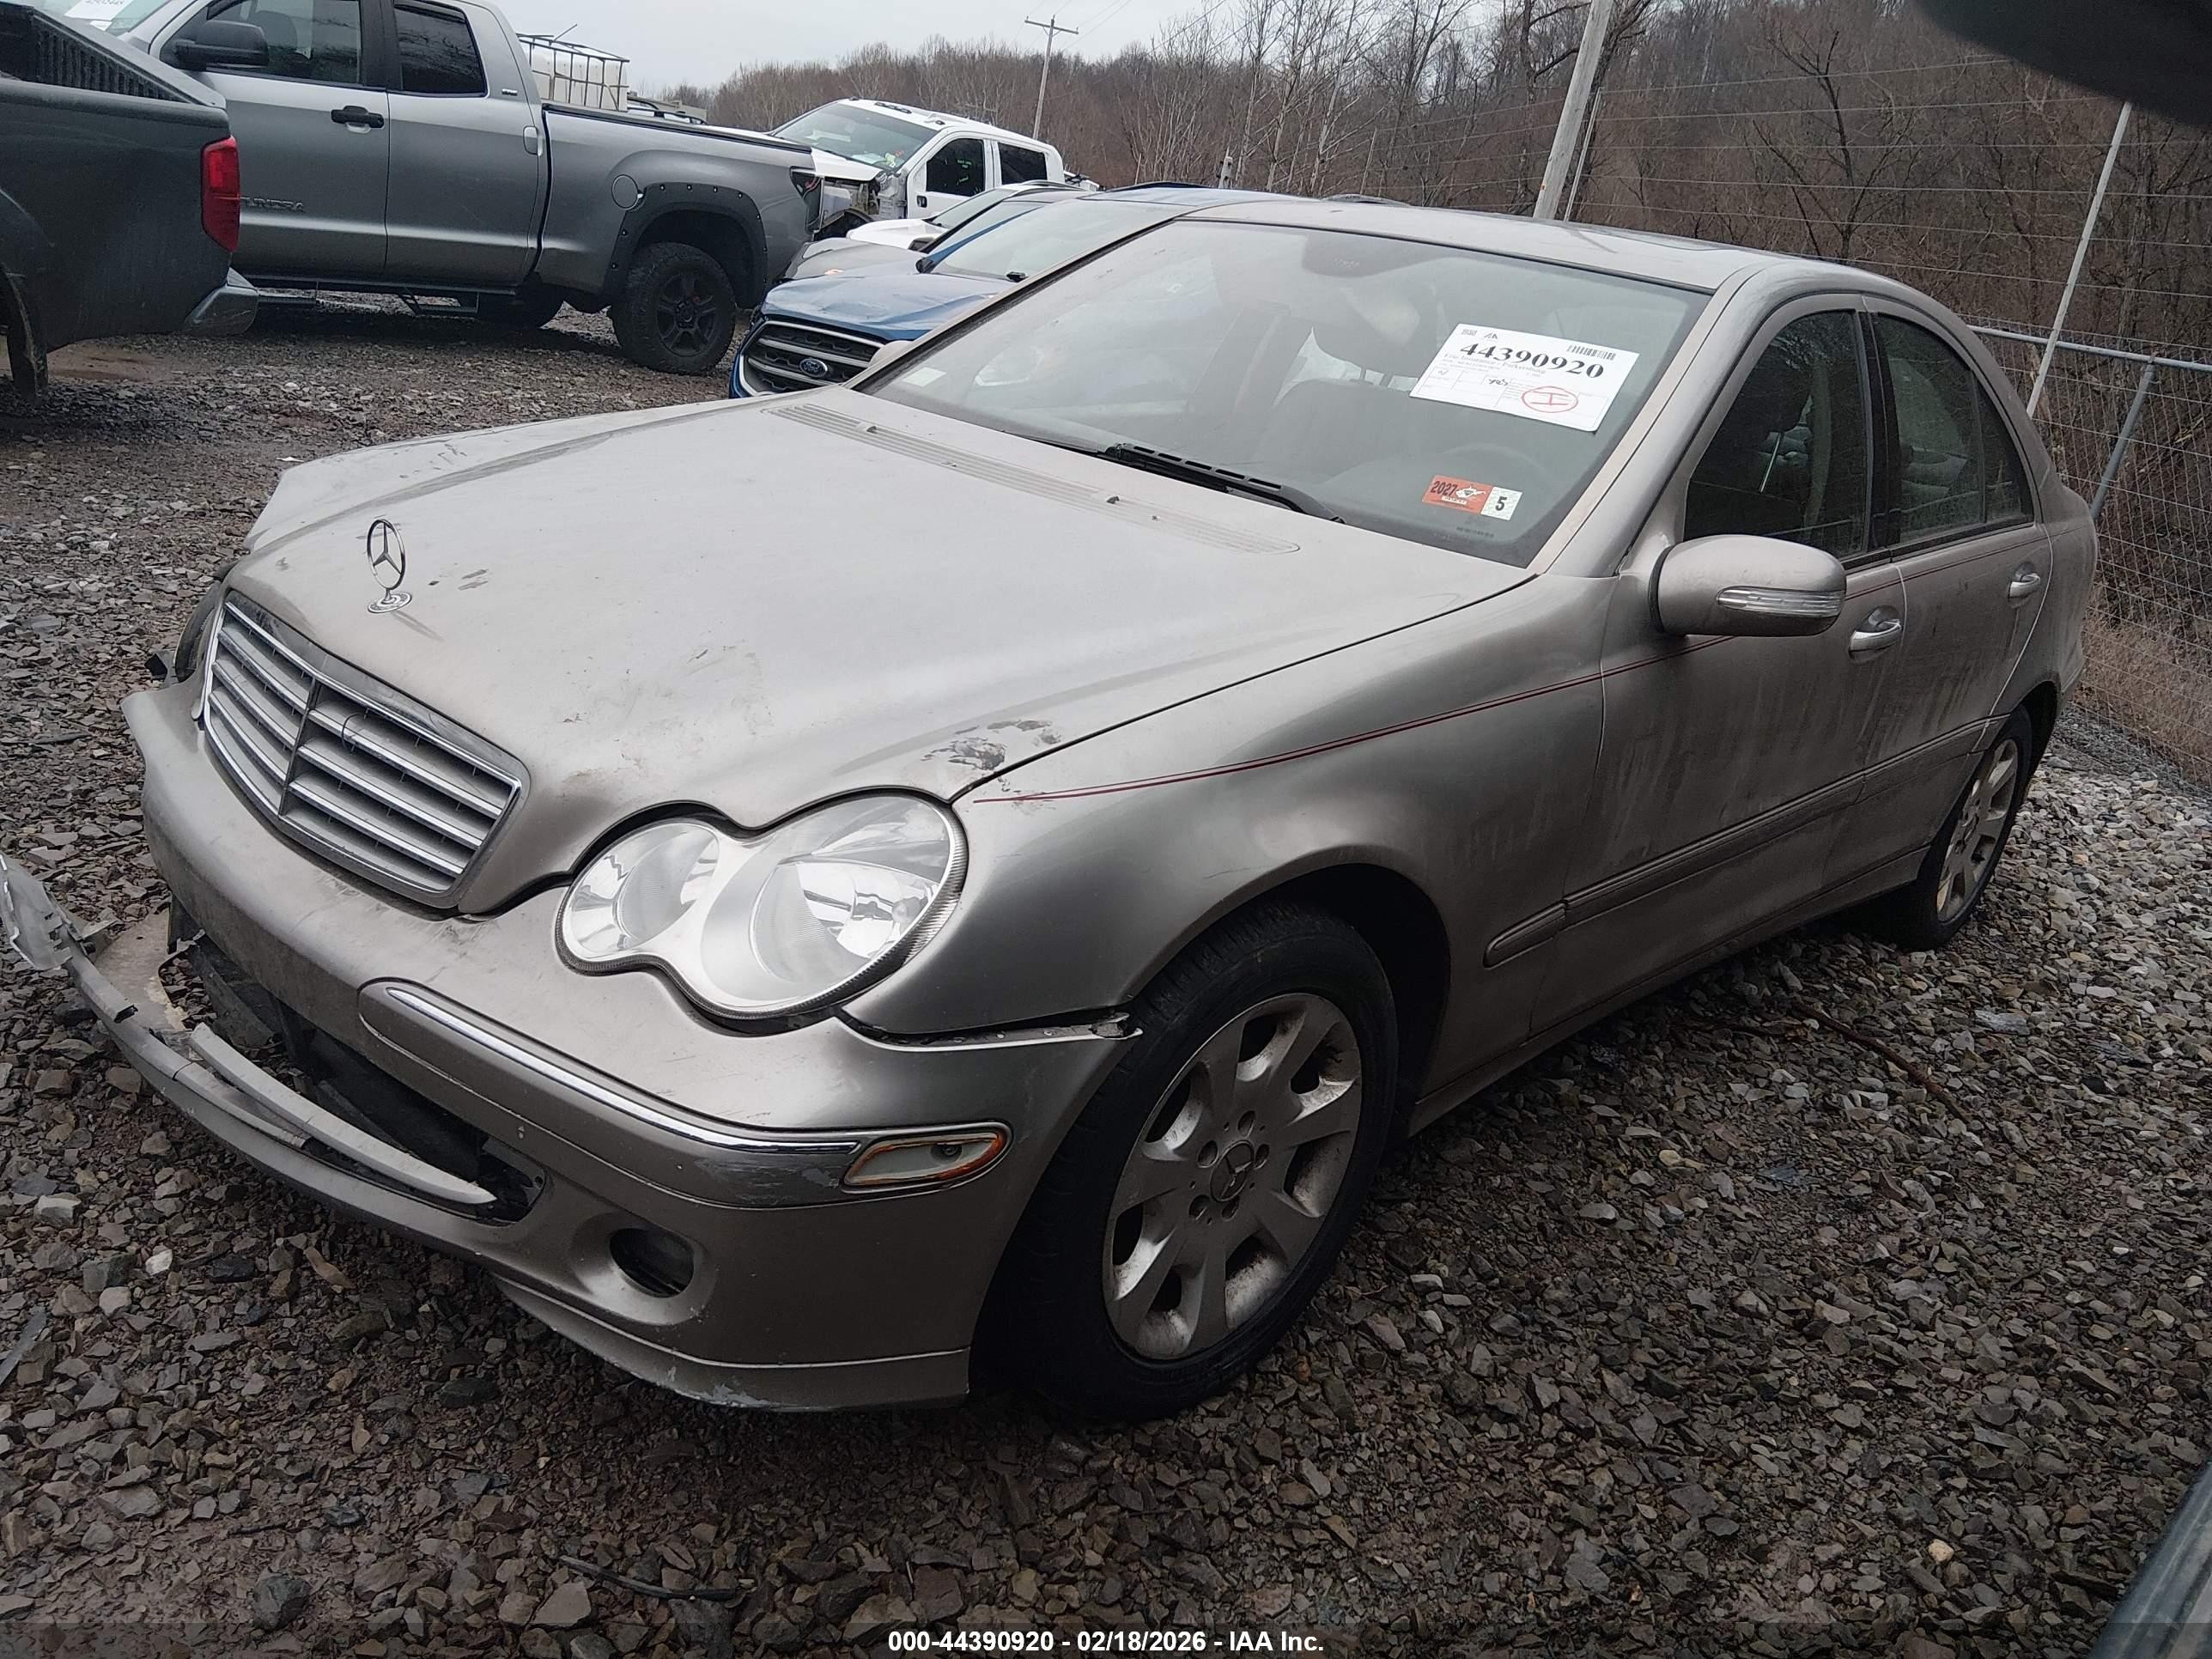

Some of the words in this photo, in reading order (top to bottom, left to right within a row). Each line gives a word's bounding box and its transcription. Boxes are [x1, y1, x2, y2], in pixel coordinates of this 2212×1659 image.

[1460, 343, 1604, 379] 44390920
[1430, 480, 1458, 497] 2027
[1495, 496, 1508, 512] 5
